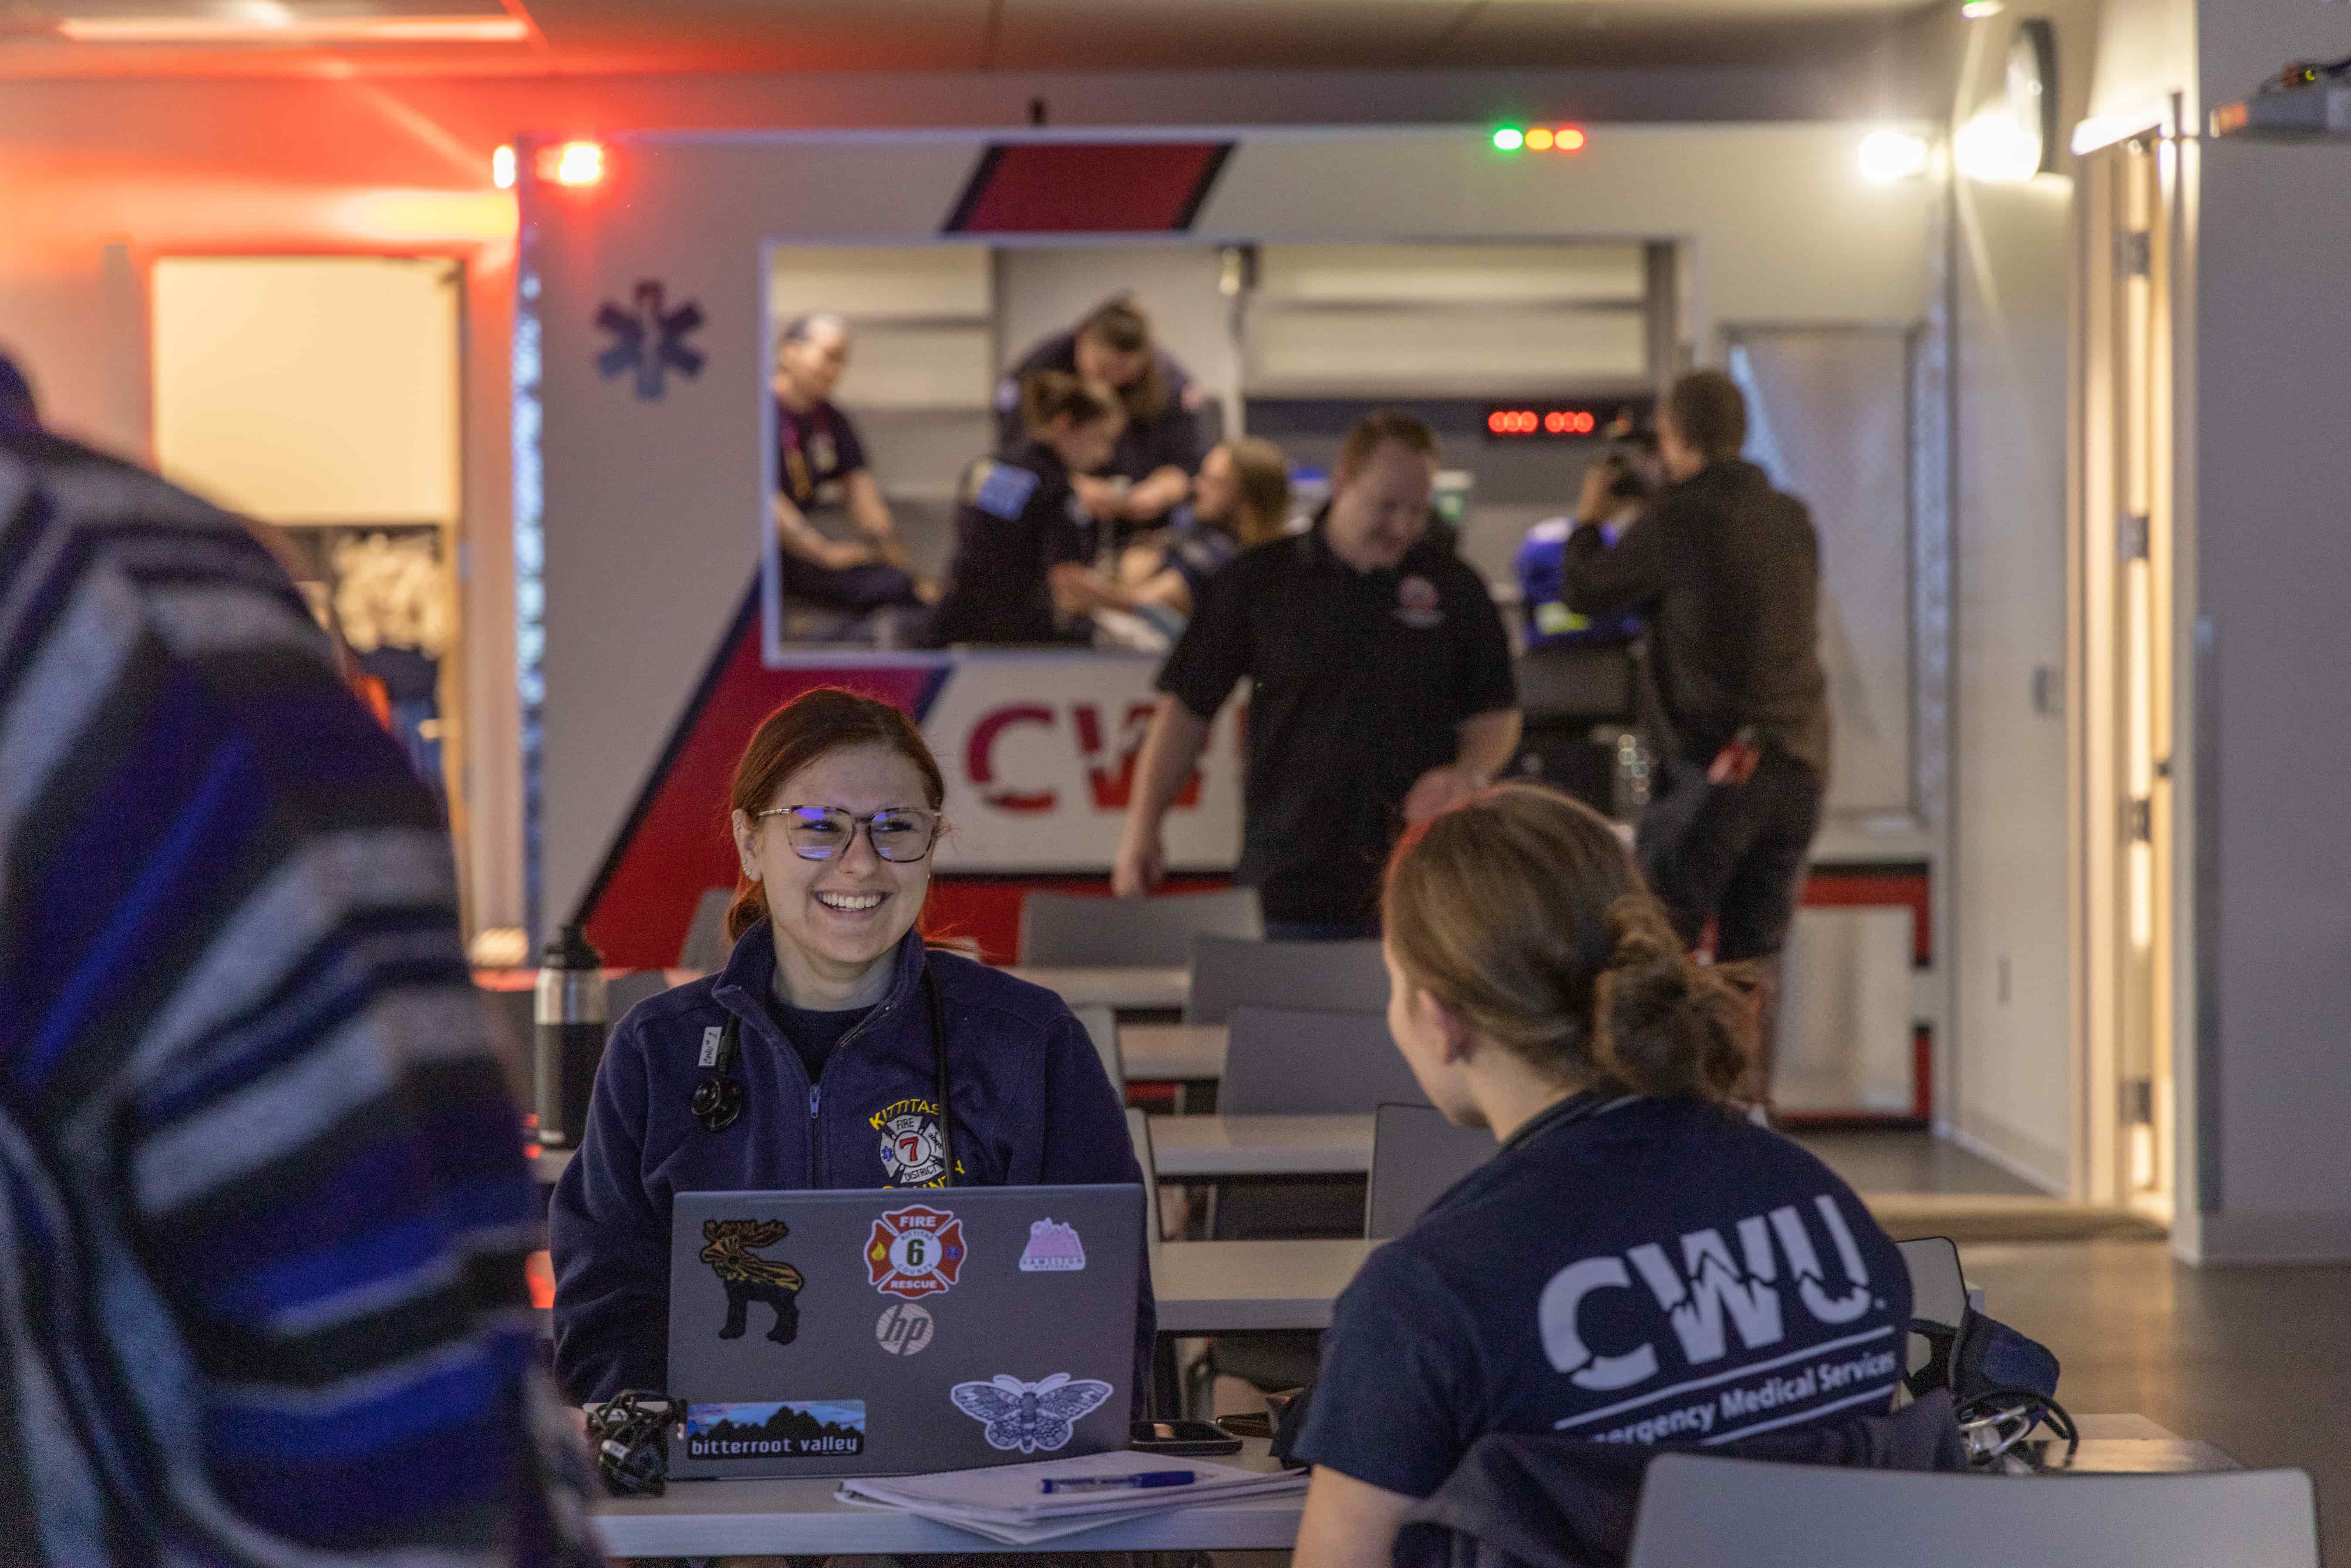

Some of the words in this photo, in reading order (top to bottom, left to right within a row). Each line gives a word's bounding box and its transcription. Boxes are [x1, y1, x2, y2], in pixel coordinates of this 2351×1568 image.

[896, 1117, 915, 1130] FIRE
[899, 1136, 919, 1162] 7
[904, 1164, 937, 1181] DISTRICT
[899, 1216, 936, 1227] FIRE
[907, 1239, 925, 1266] 6
[890, 1280, 937, 1289] RESCUE
[883, 1303, 929, 1355] hp
[1719, 1368, 1816, 1419] Medical
[691, 1439, 792, 1455] bitterroot
[800, 1436, 858, 1452] valley
